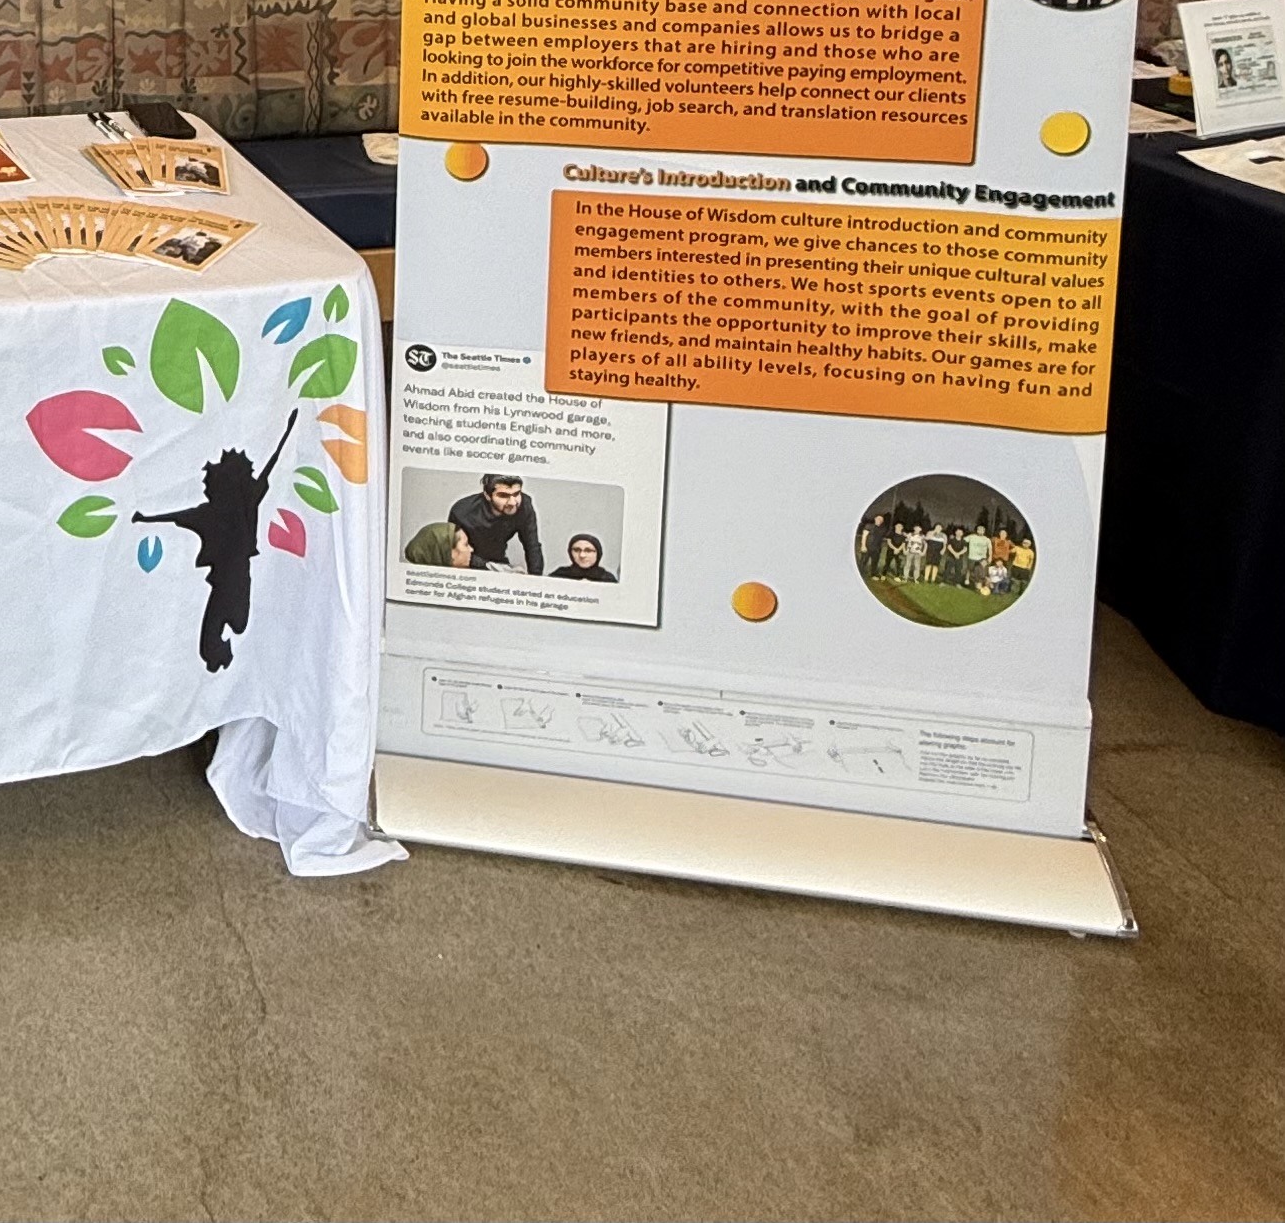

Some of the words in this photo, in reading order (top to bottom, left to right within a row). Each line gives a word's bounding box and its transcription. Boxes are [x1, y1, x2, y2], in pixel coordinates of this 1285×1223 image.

[421, 109, 494, 124] available
[499, 111, 514, 125] in
[518, 112, 545, 126] the
[549, 114, 650, 134] community.
[563, 164, 654, 185] Culture's
[658, 169, 790, 191] Introduction
[795, 175, 836, 193] and
[841, 178, 971, 204] Community
[974, 185, 1115, 210] Engagement
[576, 201, 592, 215] In
[596, 202, 624, 217] the
[629, 204, 682, 220] House
[686, 207, 704, 221] of
[707, 208, 776, 224] Wisdom
[781, 213, 843, 228] culture
[847, 216, 959, 234] introduction
[963, 224, 1000, 238] and
[1005, 229, 1108, 247] community
[442, 352, 458, 360] The
[460, 353, 492, 362] Seattle
[494, 355, 521, 364] Times
[569, 369, 630, 387] staying
[635, 372, 700, 391] healthy.
[403, 384, 445, 397] Ahmad
[448, 388, 475, 399] Abid
[478, 392, 523, 402] created
[526, 393, 545, 404] the
[549, 393, 587, 407] House
[590, 397, 602, 409] of
[403, 398, 450, 412] Wisdom
[453, 403, 480, 414] from
[483, 405, 501, 416] his
[504, 407, 564, 422] Lynnwood
[566, 414, 611, 426] garage,
[403, 414, 453, 429] teaching
[456, 420, 507, 431] students
[510, 421, 552, 435] English
[555, 427, 578, 437] and
[581, 430, 616, 441] more,
[402, 430, 425, 440] and
[427, 431, 452, 442] also
[454, 435, 527, 449] coordinating
[529, 441, 596, 455] community
[402, 444, 440, 456] events
[443, 447, 463, 457] like
[466, 451, 505, 460] soccer
[508, 453, 550, 464] games.
